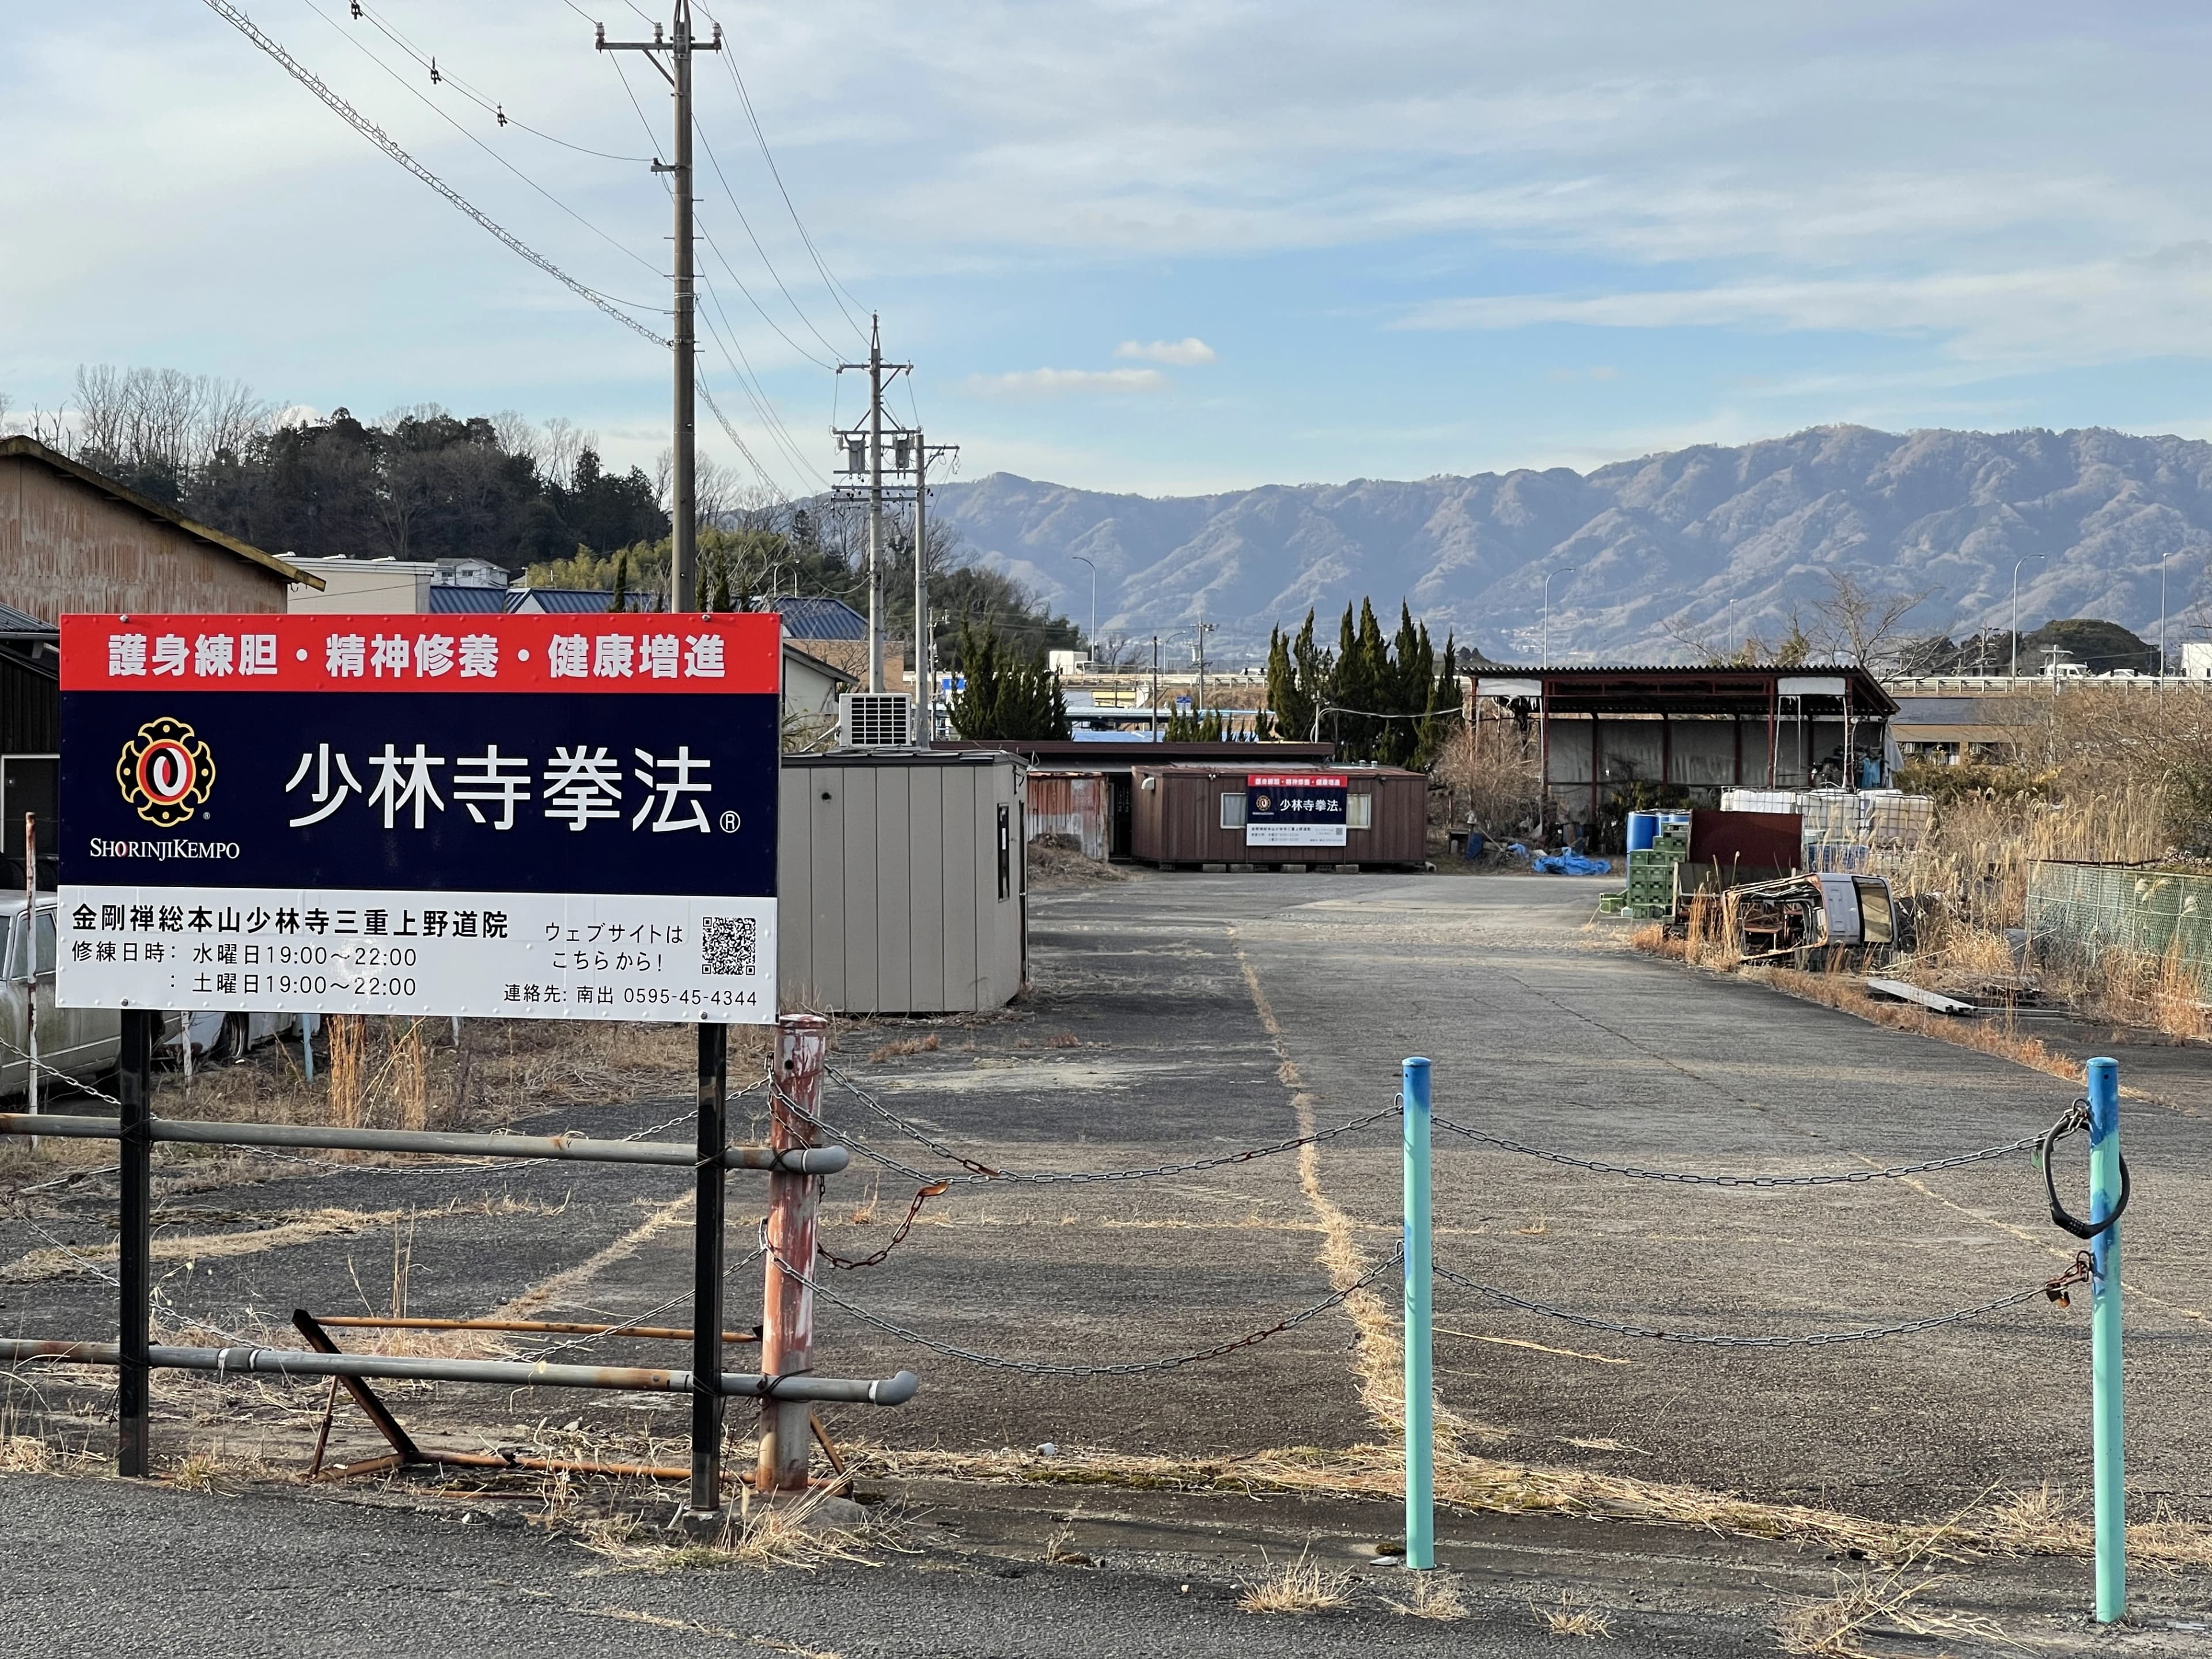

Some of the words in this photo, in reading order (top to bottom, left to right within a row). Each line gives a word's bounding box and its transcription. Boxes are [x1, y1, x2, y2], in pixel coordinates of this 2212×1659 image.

[108, 633, 725, 679] 護身練胆・精神修養・健康増進
[72, 903, 508, 938] 金剛禅総本山少林寺三重上野道院
[545, 921, 683, 944] ウェブサイトは
[577, 985, 613, 1005] 南出
[624, 988, 757, 1006] 0595-45-4344
